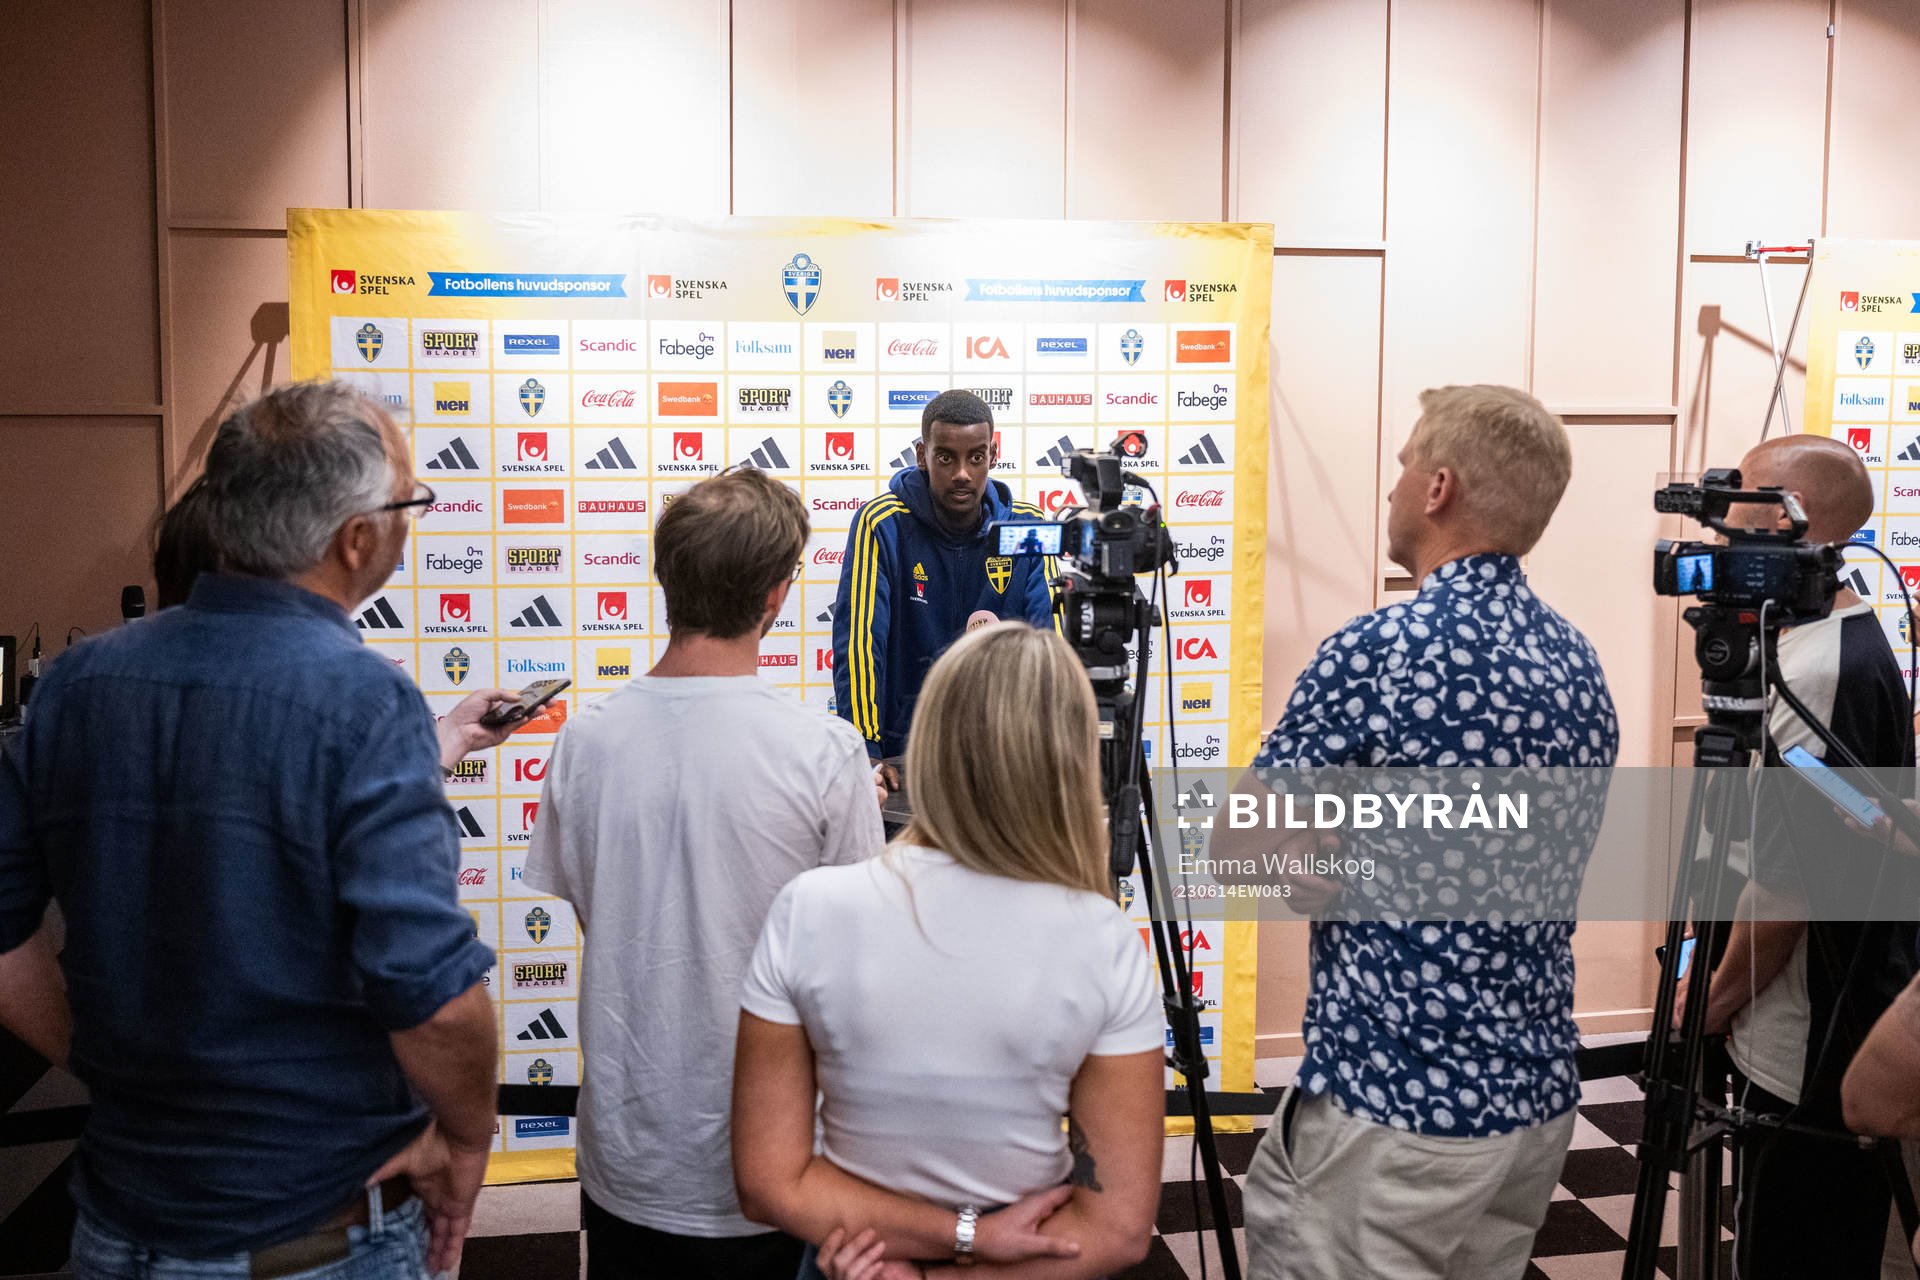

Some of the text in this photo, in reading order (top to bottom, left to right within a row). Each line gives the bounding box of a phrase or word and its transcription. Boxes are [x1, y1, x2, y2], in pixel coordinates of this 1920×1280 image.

[360, 275, 415, 286] SVENSKA
[445, 278, 611, 294] Fotbollens huvudsponsor
[676, 280, 728, 290] SVENSKA
[360, 286, 390, 296] SPEL
[902, 282, 953, 292] SVENSKA
[980, 284, 1132, 299] Fotbollens huvudsponsor
[1190, 284, 1237, 293] SVENSKA
[676, 290, 703, 299] SPEL
[902, 292, 929, 302] SPEL
[1190, 293, 1214, 302] SPEL
[1862, 296, 1902, 304] SVENSKA
[424, 332, 478, 350] SPORT
[580, 339, 636, 352] Scandic
[660, 339, 714, 360] Fabege
[736, 340, 792, 355] Folksam
[888, 338, 938, 357] Coca-Cola
[966, 336, 1010, 359] ICA
[1180, 342, 1216, 352] Swedbank
[582, 390, 636, 409] Coca-Cola
[662, 394, 701, 405] Swedbank
[740, 389, 790, 405] SPORT
[964, 388, 1012, 405] PORT
[1030, 394, 1092, 405] BAUHAUS
[1106, 392, 1158, 405] Scandic
[1178, 392, 1228, 410] Fabege
[1840, 394, 1884, 406] Folksam
[544, 464, 564, 472] SPEL
[658, 464, 696, 472] SVENSKA
[1141, 460, 1160, 468] SPEL
[1894, 486, 1920, 497] Scan
[1176, 490, 1225, 507] Coca-Cola
[507, 502, 547, 511] Swedbank
[579, 501, 646, 512] BAUHAUS
[1892, 532, 1920, 548] Fabe
[508, 548, 561, 565] SPORT
[1174, 542, 1224, 562] Fabege
[426, 554, 483, 574] Fabege
[584, 554, 640, 565] Scandic
[1170, 610, 1205, 618] SVENSKA
[424, 626, 464, 634] SVENSKA
[582, 623, 644, 632] SVENSKA SPEL
[1176, 638, 1218, 660] ICA
[507, 659, 566, 673] Folksam
[759, 656, 797, 666] HAUS
[1179, 930, 1211, 952] CA
[514, 963, 565, 980] SPORT
